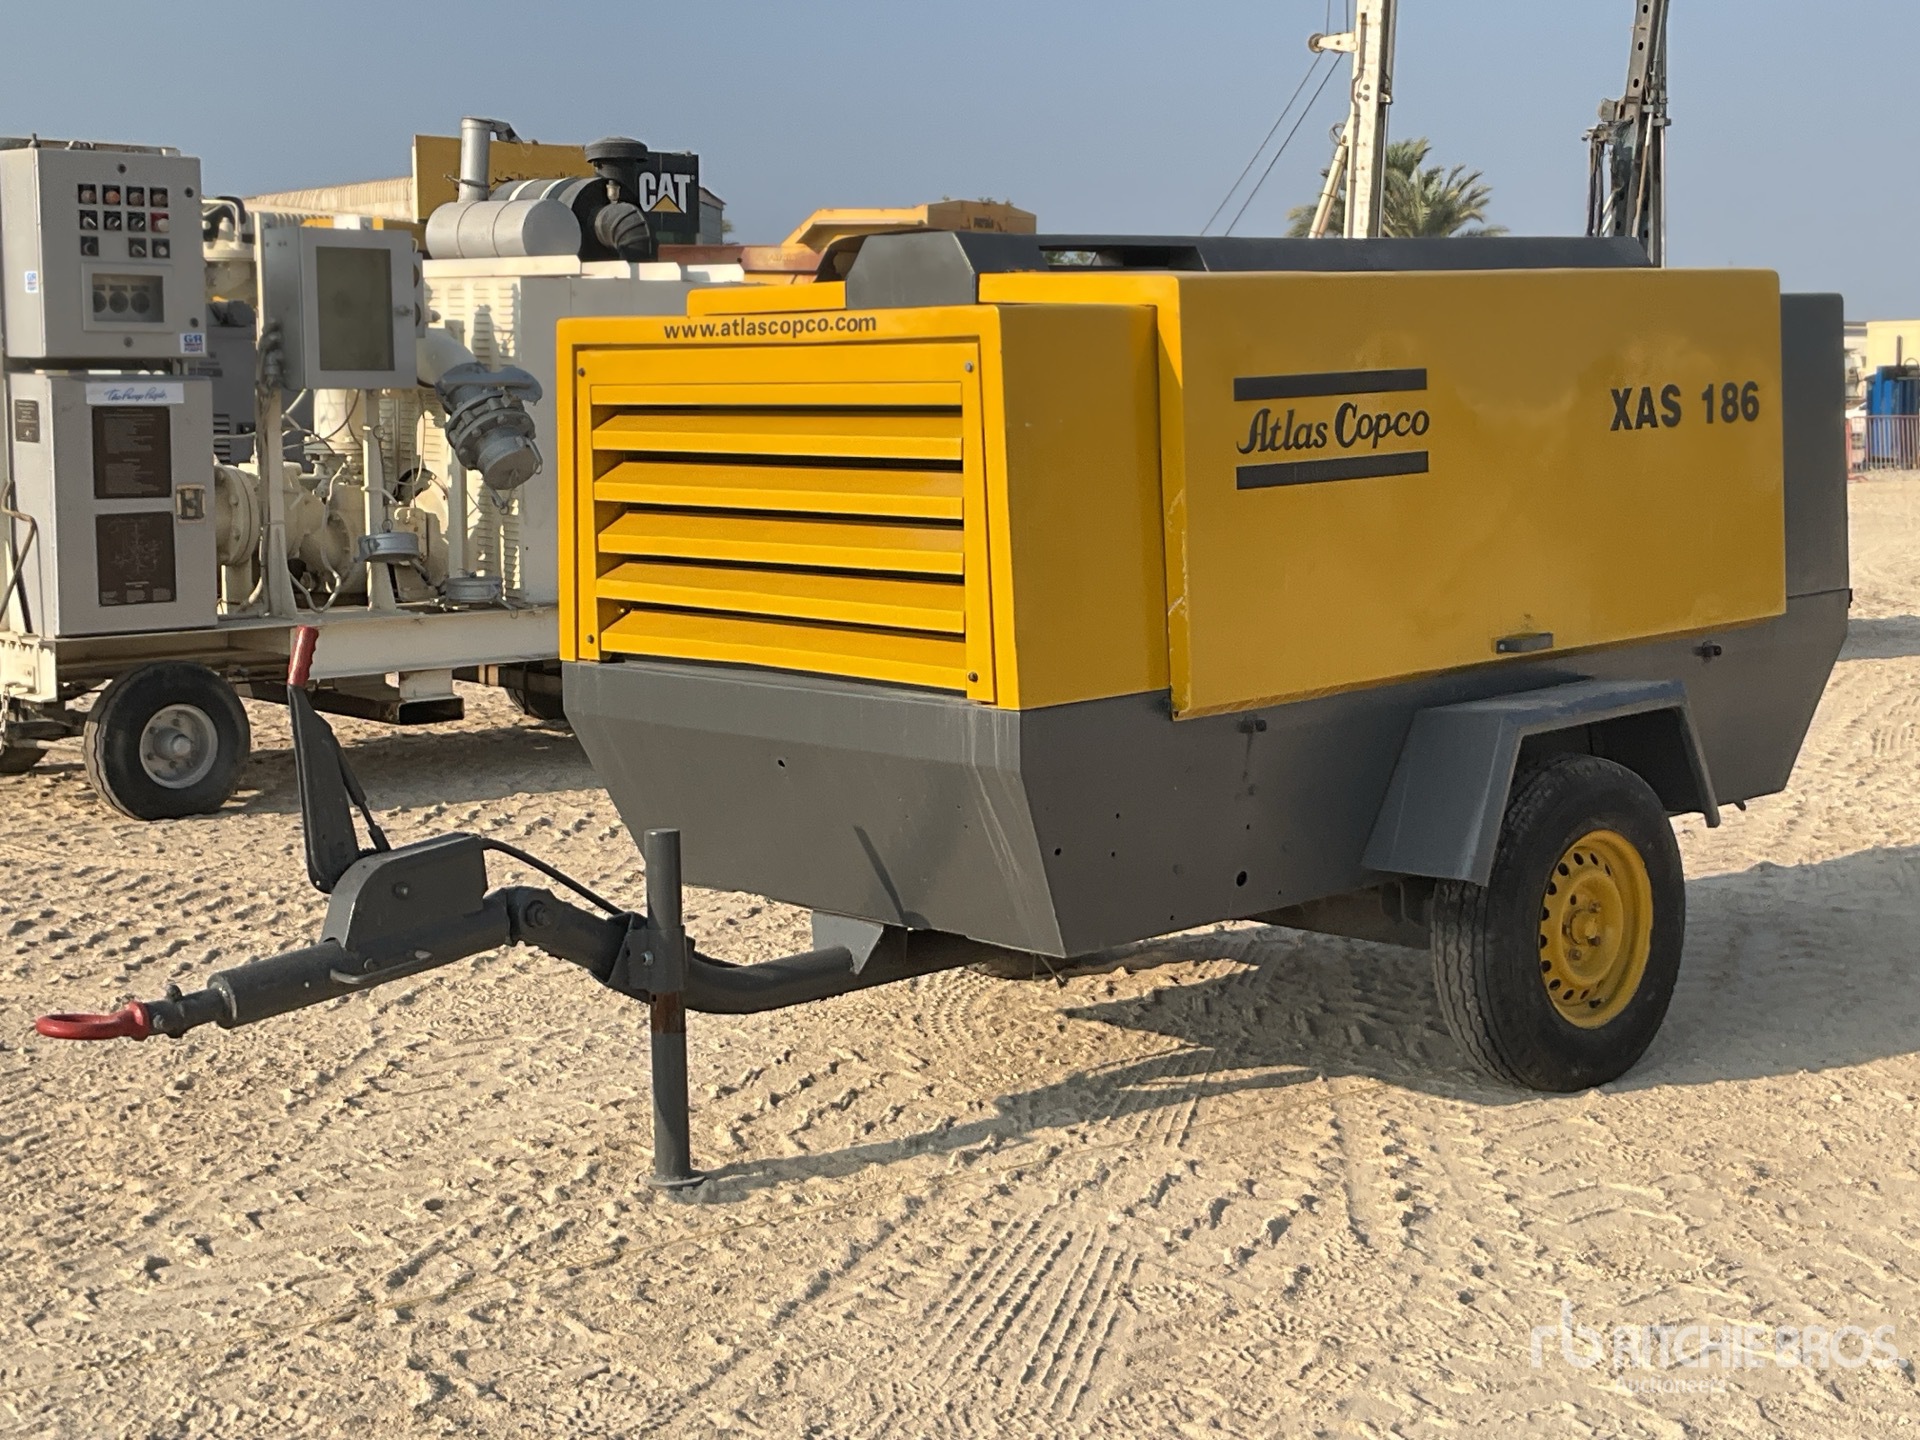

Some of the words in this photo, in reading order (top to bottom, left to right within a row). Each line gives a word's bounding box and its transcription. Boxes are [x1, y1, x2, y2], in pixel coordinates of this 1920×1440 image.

[638, 171, 691, 214] CAT
[664, 316, 876, 339] www.atlascopco.com
[1236, 408, 1328, 454] Atlas
[1334, 402, 1430, 449] Copco
[1610, 384, 1682, 431] XAS
[1702, 381, 1760, 424] 186
